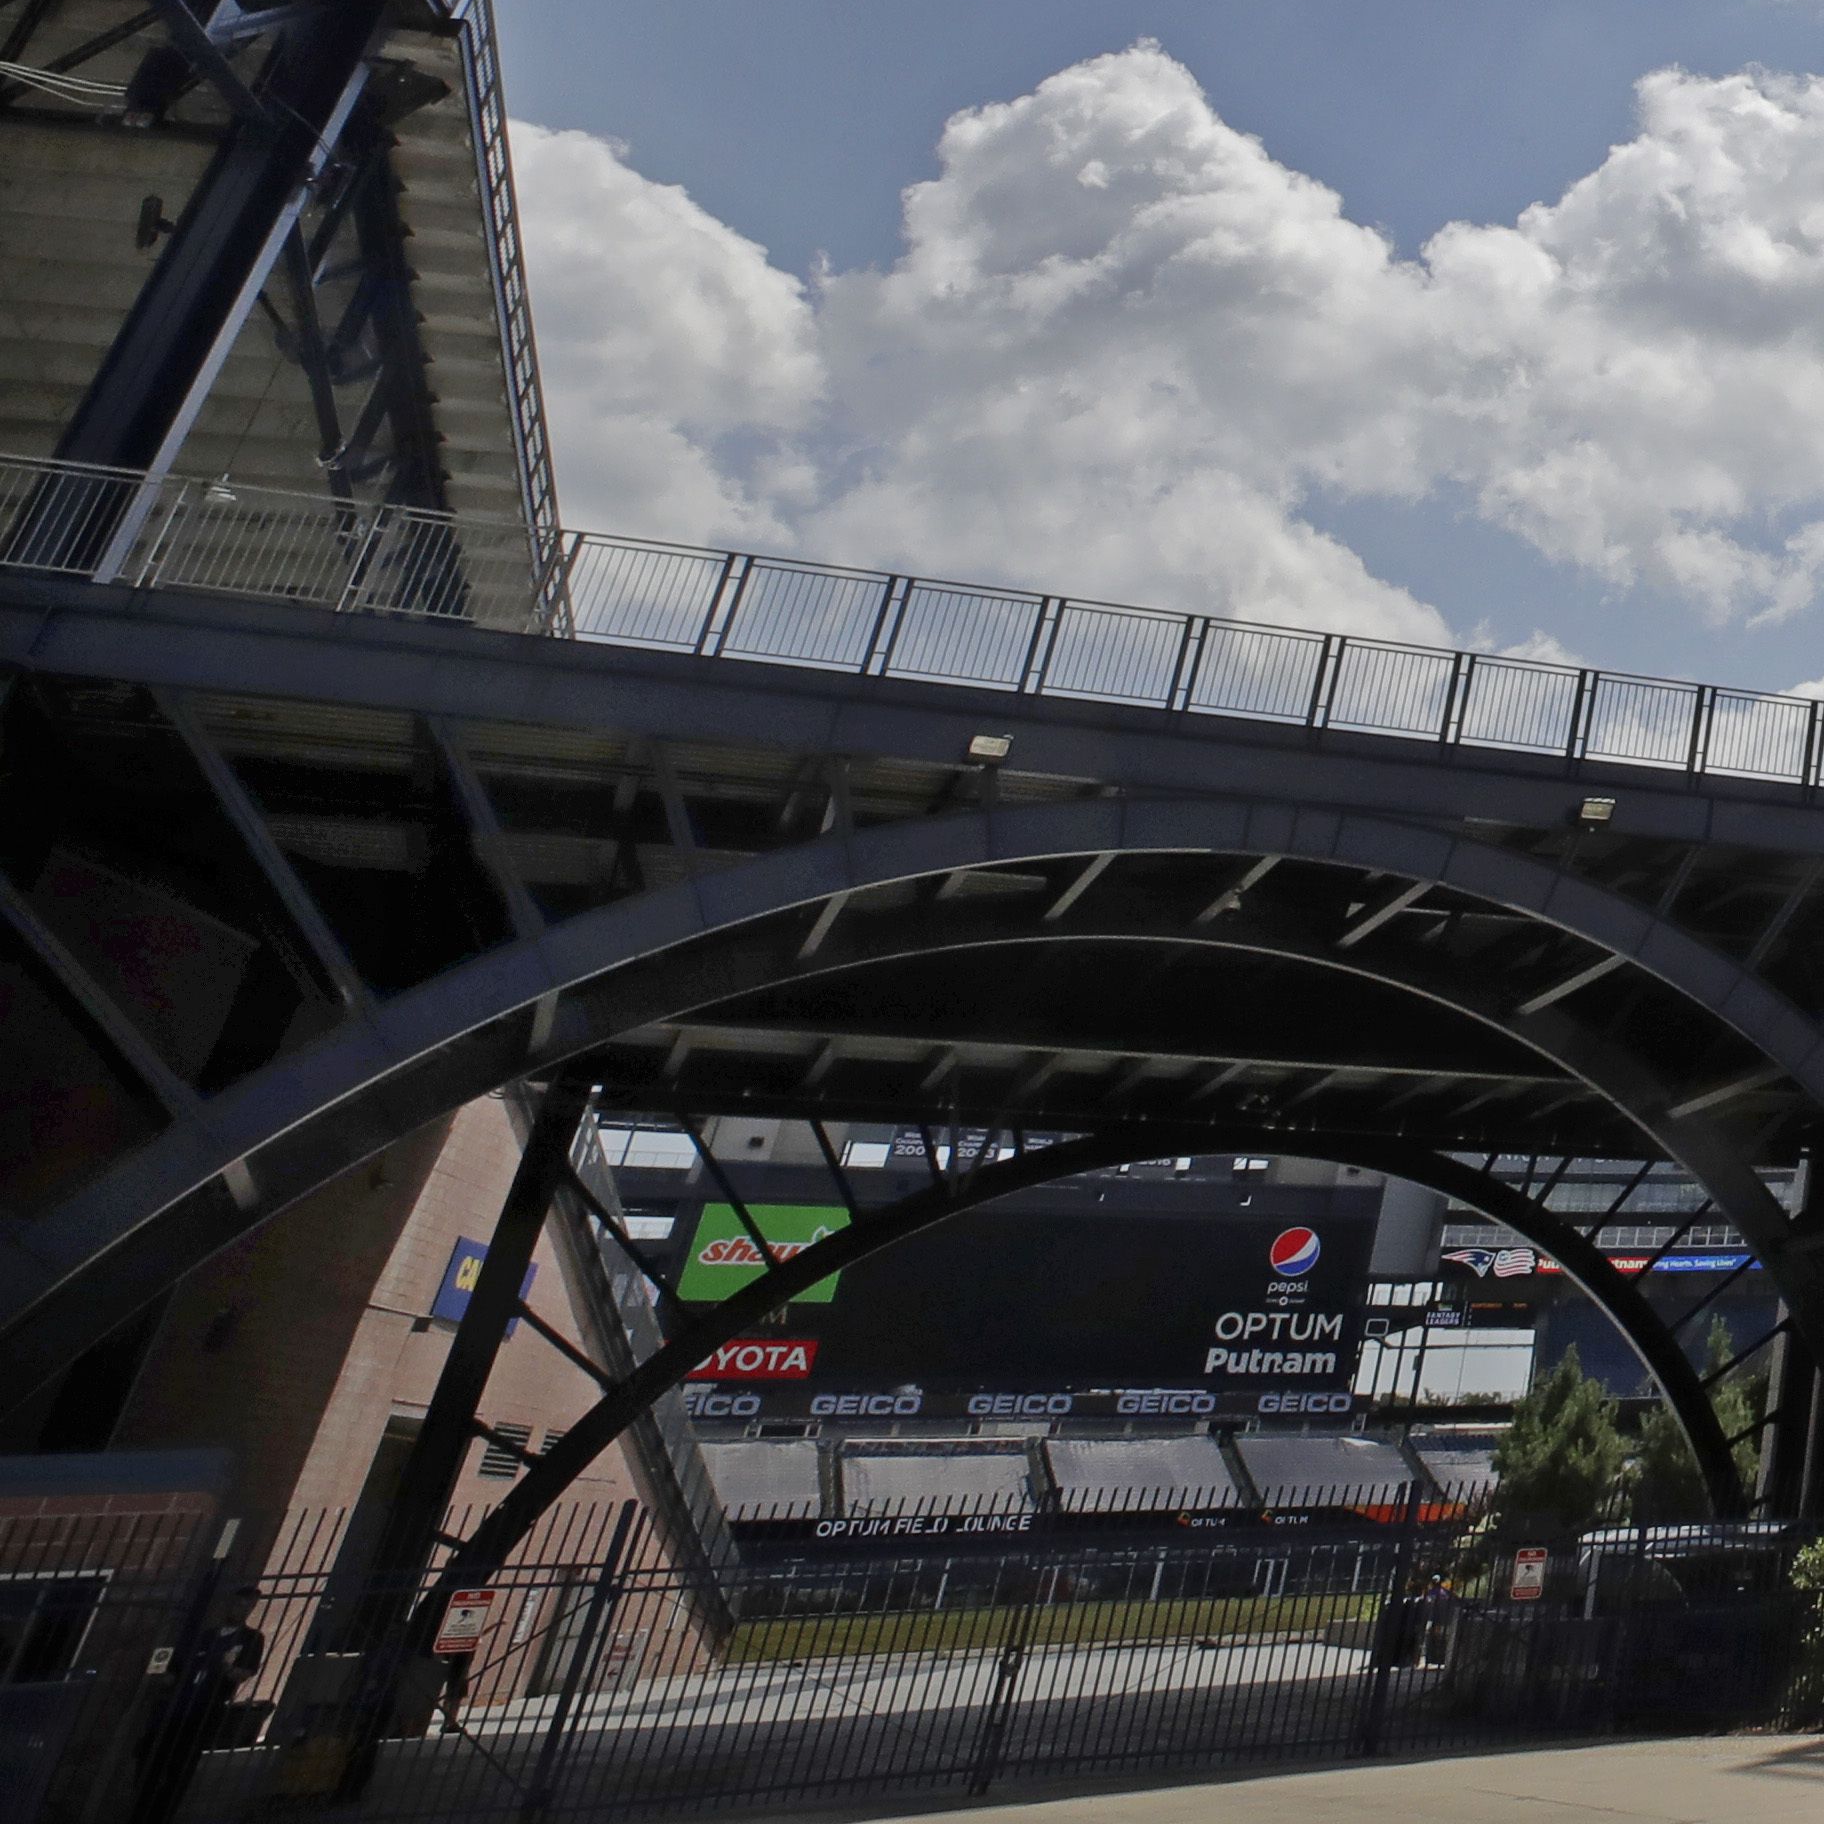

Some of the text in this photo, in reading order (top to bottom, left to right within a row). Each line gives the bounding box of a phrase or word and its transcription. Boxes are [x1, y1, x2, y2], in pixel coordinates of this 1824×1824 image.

[894, 1145, 926, 1156] 200
[957, 1148, 995, 1159] 203
[1267, 1280, 1309, 1295] pepsi
[1214, 1311, 1344, 1342] OPTUM
[693, 1345, 808, 1372] YOTA
[1204, 1347, 1337, 1374] Putnam
[685, 1395, 761, 1416] EICO
[810, 1394, 924, 1416] GEICO
[967, 1393, 1073, 1414] GEICO
[1116, 1393, 1216, 1414] GEICO
[1257, 1393, 1351, 1413] GEICO
[816, 1519, 890, 1537] OPTUM
